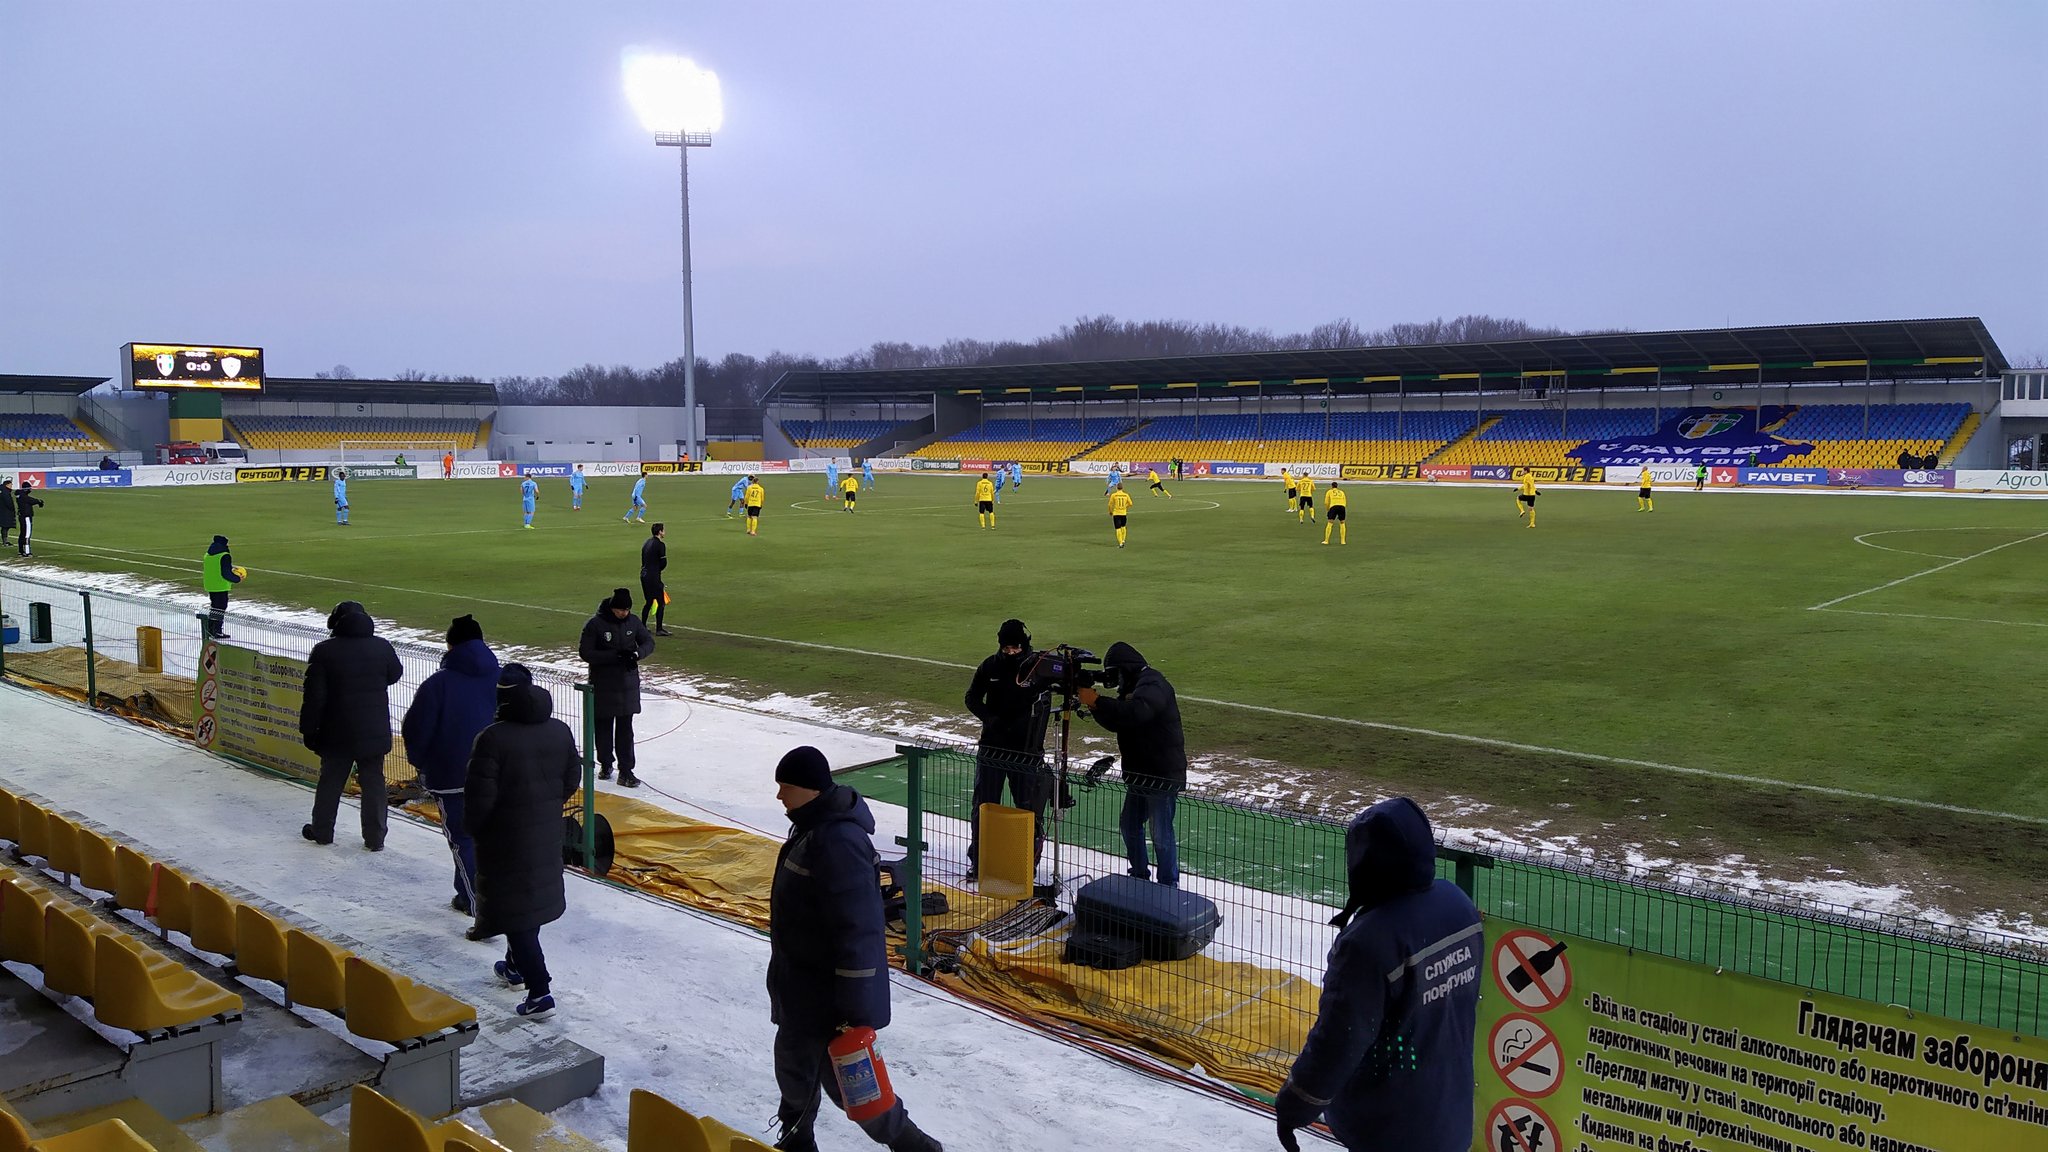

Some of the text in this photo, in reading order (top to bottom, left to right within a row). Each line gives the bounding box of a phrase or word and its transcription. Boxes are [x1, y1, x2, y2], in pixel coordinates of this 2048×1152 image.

[594, 463, 638, 475] AgroVista
[721, 463, 759, 471] AgroVista
[878, 460, 911, 469] AgroVista
[1217, 466, 1258, 475] FAVBET
[1288, 464, 1337, 477] AgroVista
[240, 471, 280, 479] ФУТБОЛ
[452, 465, 496, 478] groVista
[523, 467, 566, 475] FAVBET
[1345, 468, 1378, 476] ФУТБОЛ
[1516, 470, 1555, 478] ФТБОЛ
[1748, 472, 1816, 482] FAVBET
[56, 474, 122, 485] FAVBET
[165, 470, 232, 485] AgroVista
[750, 490, 759, 499] 47
[1117, 497, 1125, 507] 11
[1424, 946, 1472, 981] СЛУЖБА
[1422, 965, 1477, 1006] ПОРЯТУНКУ
[1798, 1000, 1916, 1060] Глядачам
[1592, 992, 1618, 1021] Вхід
[1622, 1005, 1636, 1023] на
[1639, 1009, 1687, 1037] стадіон
[1691, 1023, 1700, 1044] у
[1702, 1026, 1738, 1050] стані
[1740, 1034, 1836, 1075] алкогольного
[1839, 1058, 1866, 1082] або
[1870, 1068, 1979, 1110] наркотичного
[1588, 1026, 1886, 1124] наркотичних речовин на території стадіону.
[1584, 1052, 1647, 1090] Перегляд
[1650, 1072, 1690, 1101] матчу
[1692, 1083, 1701, 1104] у
[1703, 1087, 1737, 1110] стані
[1740, 1098, 1835, 1139] алкогольного
[1838, 1124, 1866, 1148] або
[1582, 1087, 1792, 1152] метальними чи піротехнічними
[1580, 1112, 1635, 1146] Кидання
[1638, 1132, 1654, 1151] на
